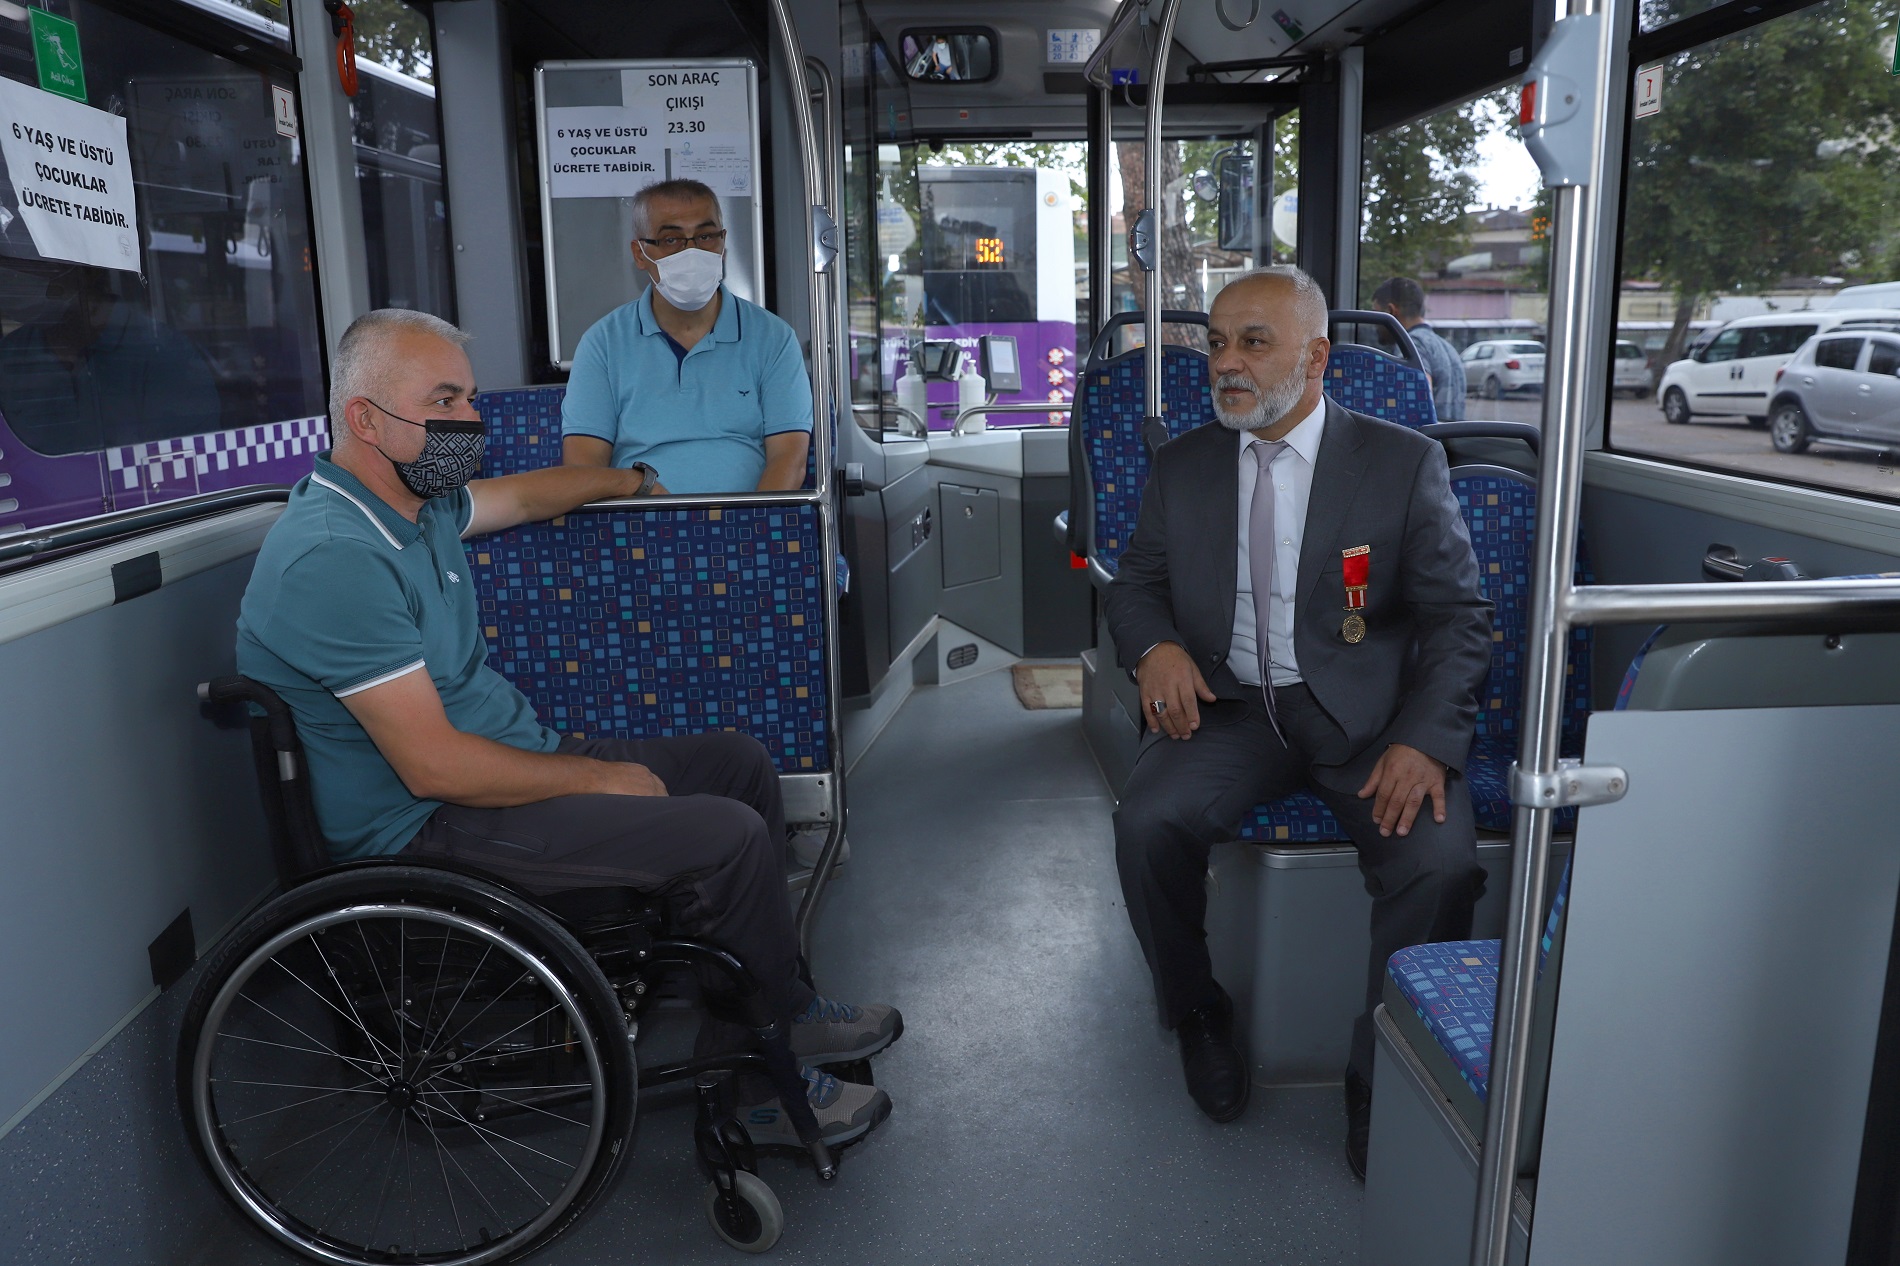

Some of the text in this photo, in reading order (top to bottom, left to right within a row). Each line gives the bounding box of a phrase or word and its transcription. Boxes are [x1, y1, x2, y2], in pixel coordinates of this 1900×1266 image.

[648, 72, 720, 87] SON ARAÇ
[666, 96, 704, 111] ÇIKIŞI
[557, 126, 648, 140] 6 YAŞ VE ÜSTÜ
[667, 120, 705, 134] 23.30
[12, 122, 114, 166] 6 YAŞ VE ÜSTÜ
[570, 146, 636, 157] ÇOCUKLAR
[553, 161, 655, 173] ÜCRETE TABİDİR.
[35, 161, 108, 194] ÇOCUKLAR
[22, 187, 129, 229] ÜCRETE TABİDİR.
[976, 238, 1004, 262] 52
